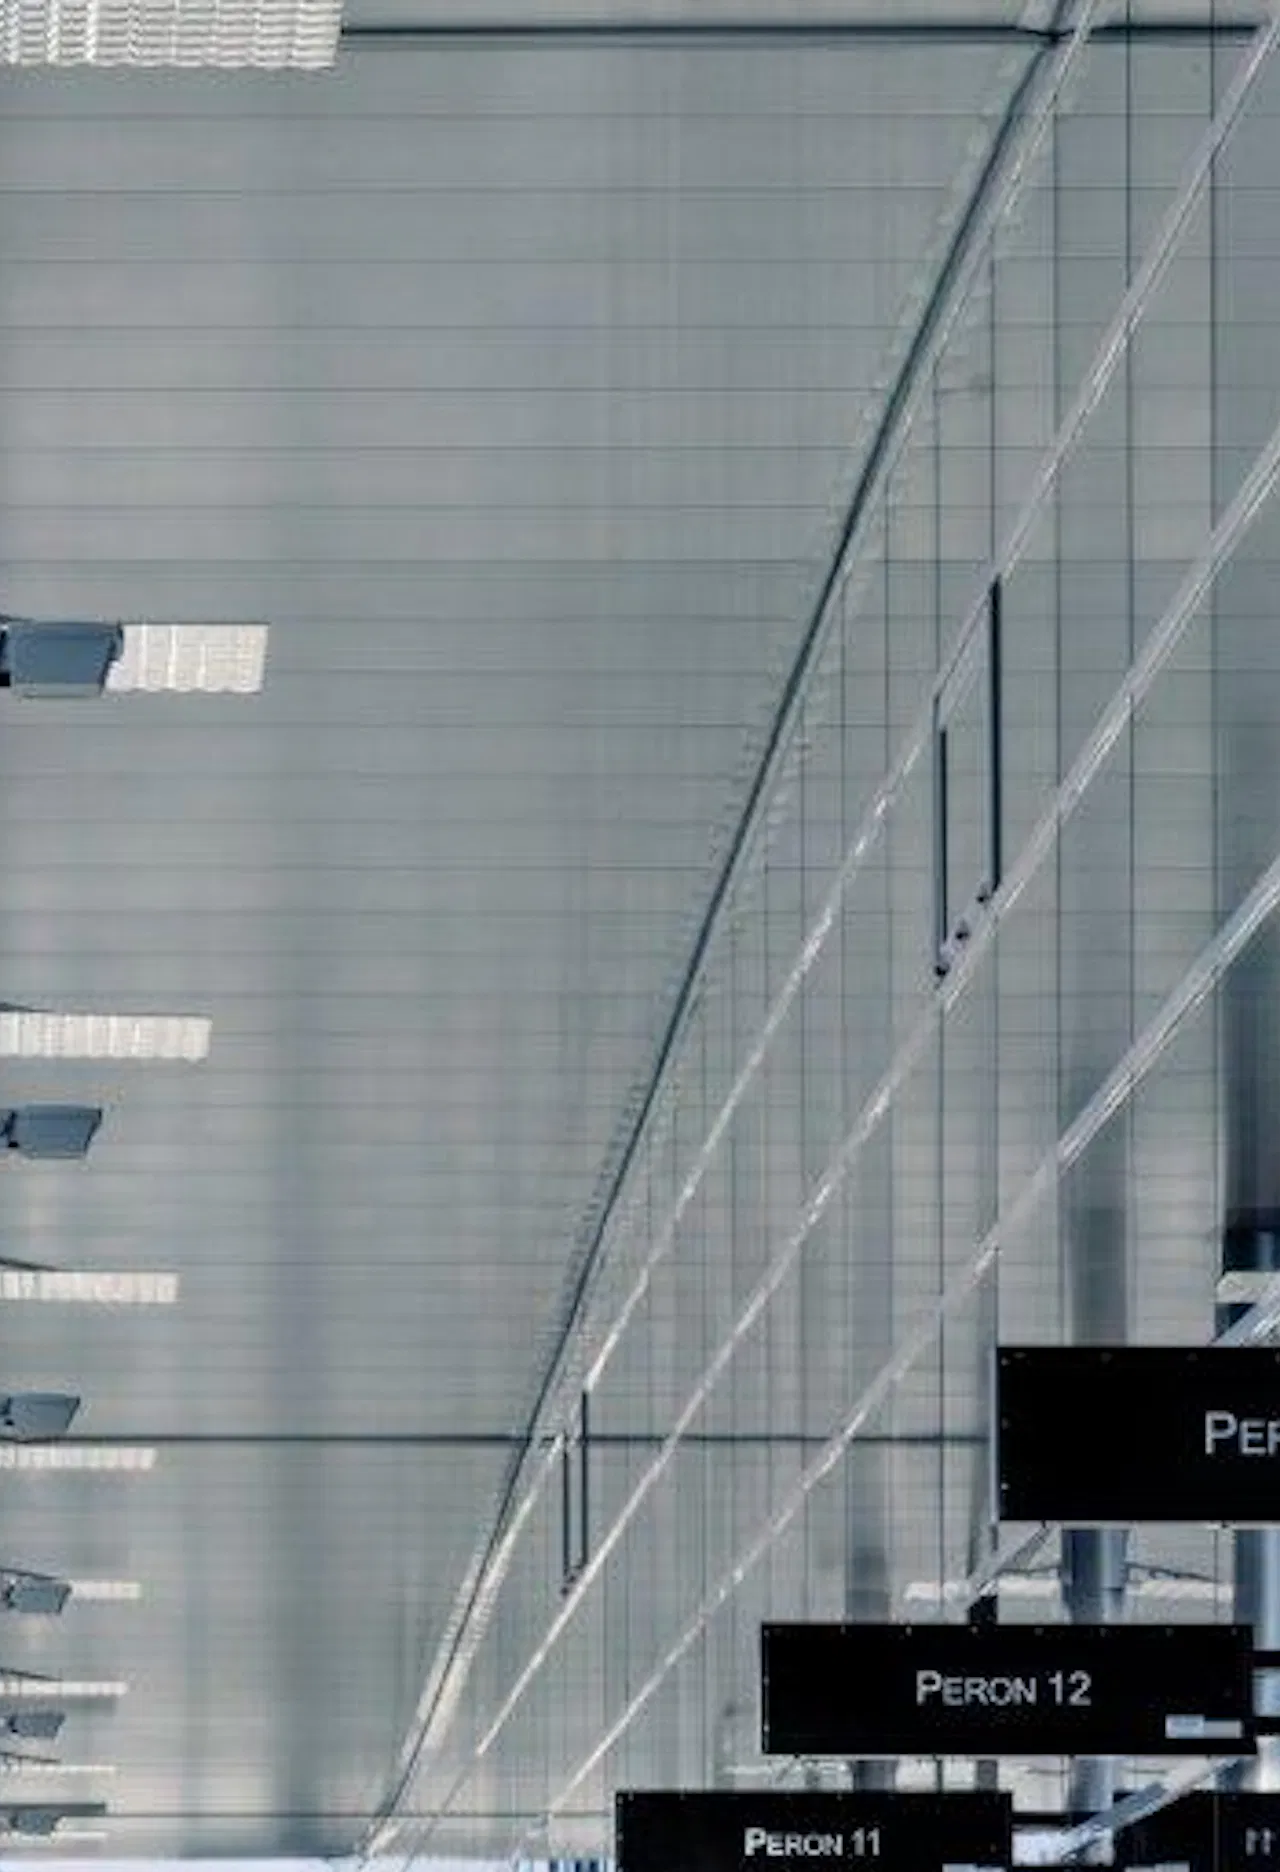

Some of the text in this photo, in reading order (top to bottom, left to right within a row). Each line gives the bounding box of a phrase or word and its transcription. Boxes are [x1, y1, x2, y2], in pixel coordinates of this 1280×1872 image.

[916, 1670, 1091, 1706] PERON 12
[851, 1828, 880, 1856] 11
